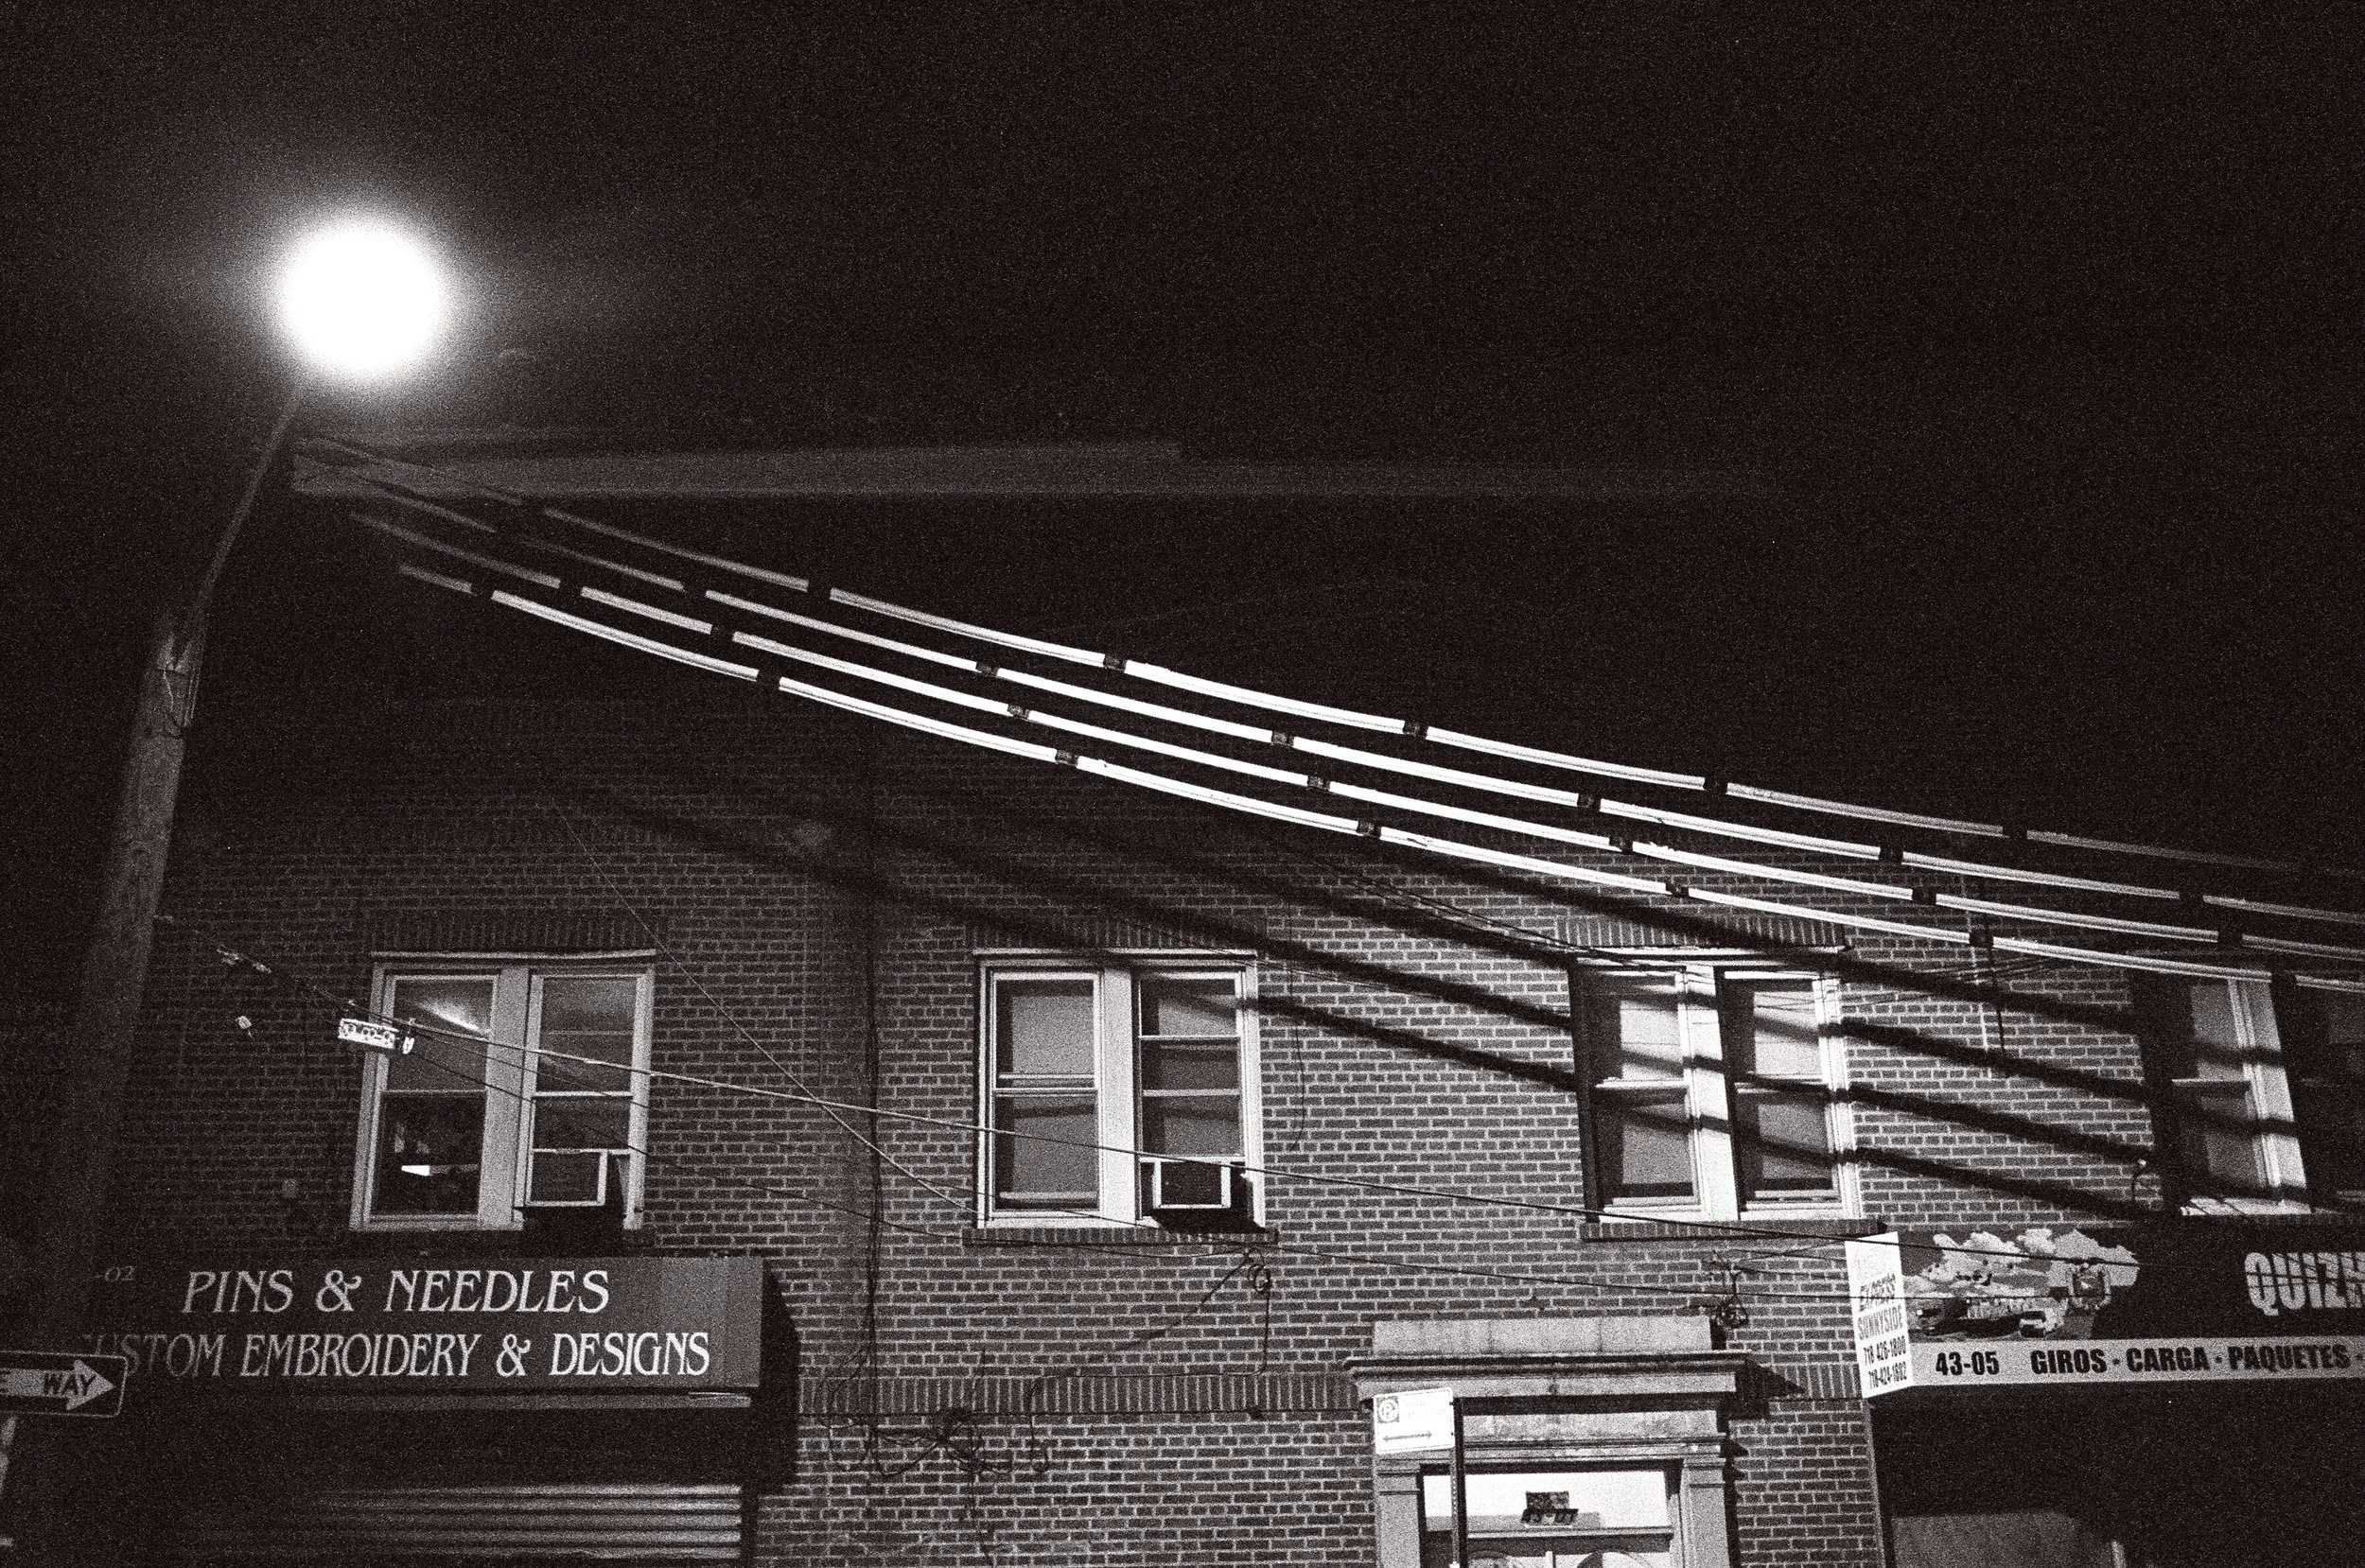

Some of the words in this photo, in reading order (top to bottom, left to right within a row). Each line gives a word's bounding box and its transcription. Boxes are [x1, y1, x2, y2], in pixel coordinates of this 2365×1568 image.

[182, 1269, 294, 1314] PINS
[315, 1269, 361, 1313] &
[383, 1269, 609, 1314] NEEDLES
[239, 1332, 482, 1377] EMBROIDERY
[496, 1333, 532, 1378] &
[549, 1332, 710, 1377] DESIGNS
[1935, 1350, 2000, 1376] 43-05
[2030, 1349, 2108, 1374] GIROS
[2126, 1347, 2212, 1372] CARGA
[2228, 1344, 2352, 1372] PAQUETES
[43, 1372, 96, 1397] WAY
